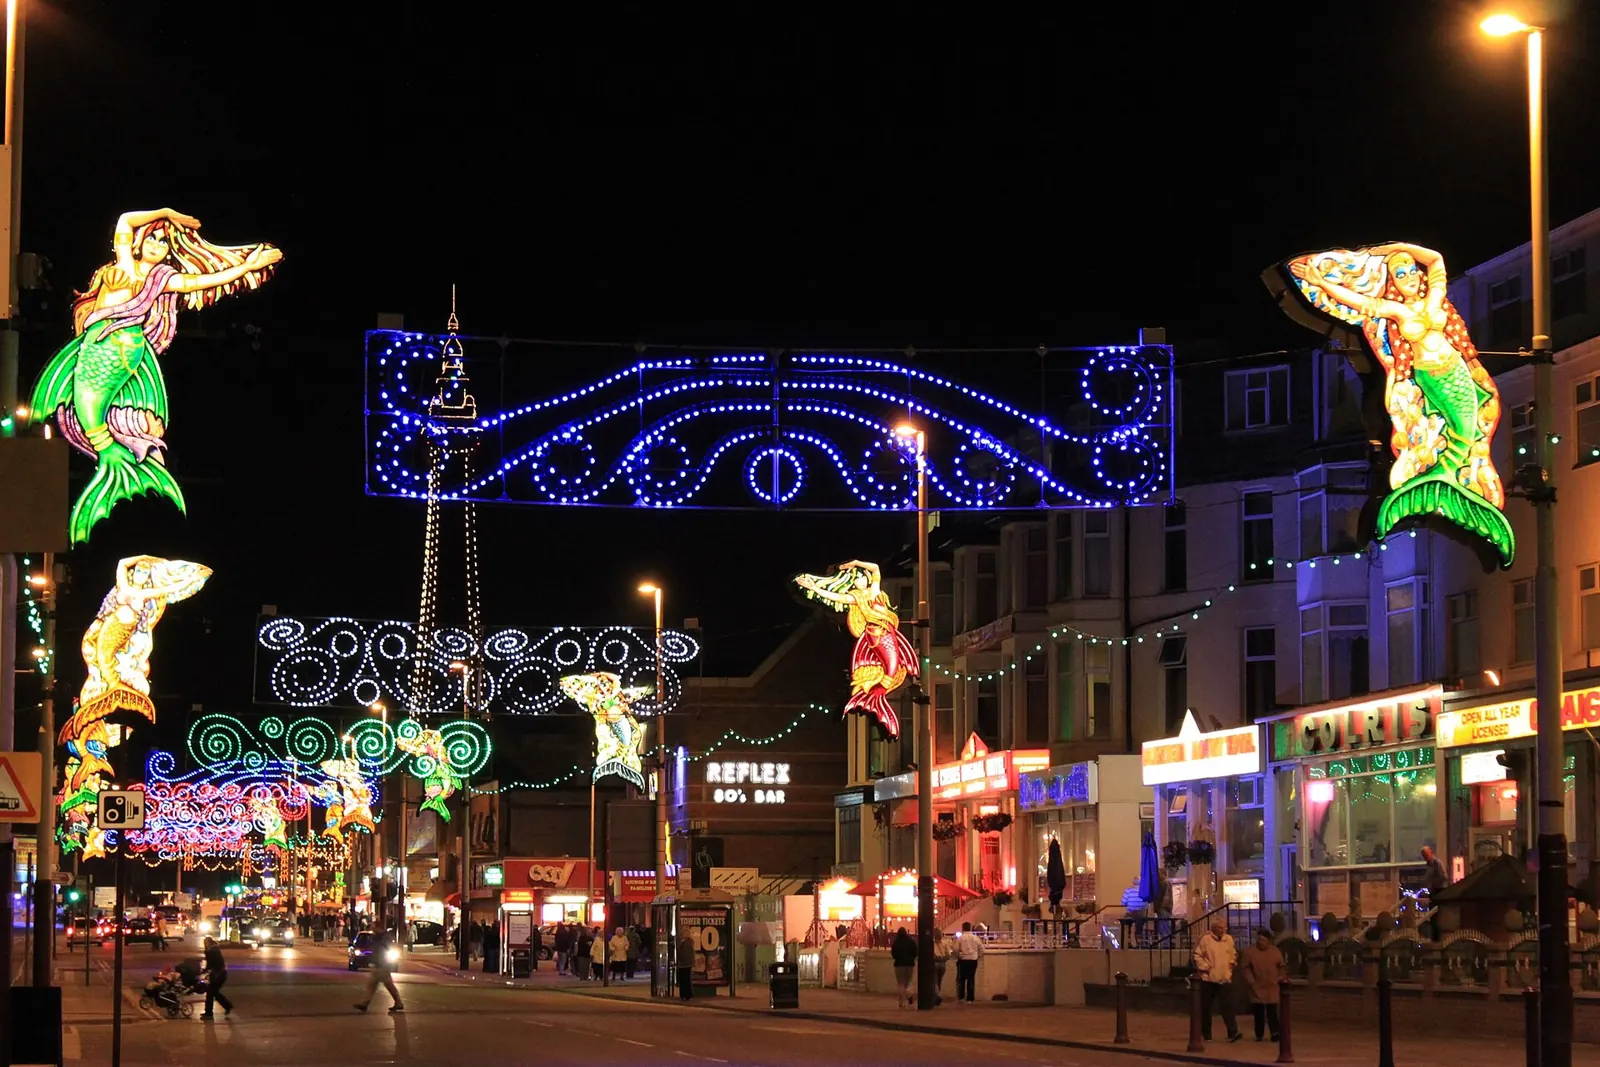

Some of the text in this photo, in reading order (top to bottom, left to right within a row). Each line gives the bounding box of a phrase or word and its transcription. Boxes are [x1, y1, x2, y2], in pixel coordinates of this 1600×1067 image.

[1302, 698, 1429, 750] COLRIS
[1461, 705, 1521, 725] OPEN ALL YEAR
[1471, 724, 1509, 740] LICENSED
[706, 762, 790, 785] REFLEX
[754, 789, 786, 804] BAR
[680, 917, 726, 926] TOWER TICKETS
